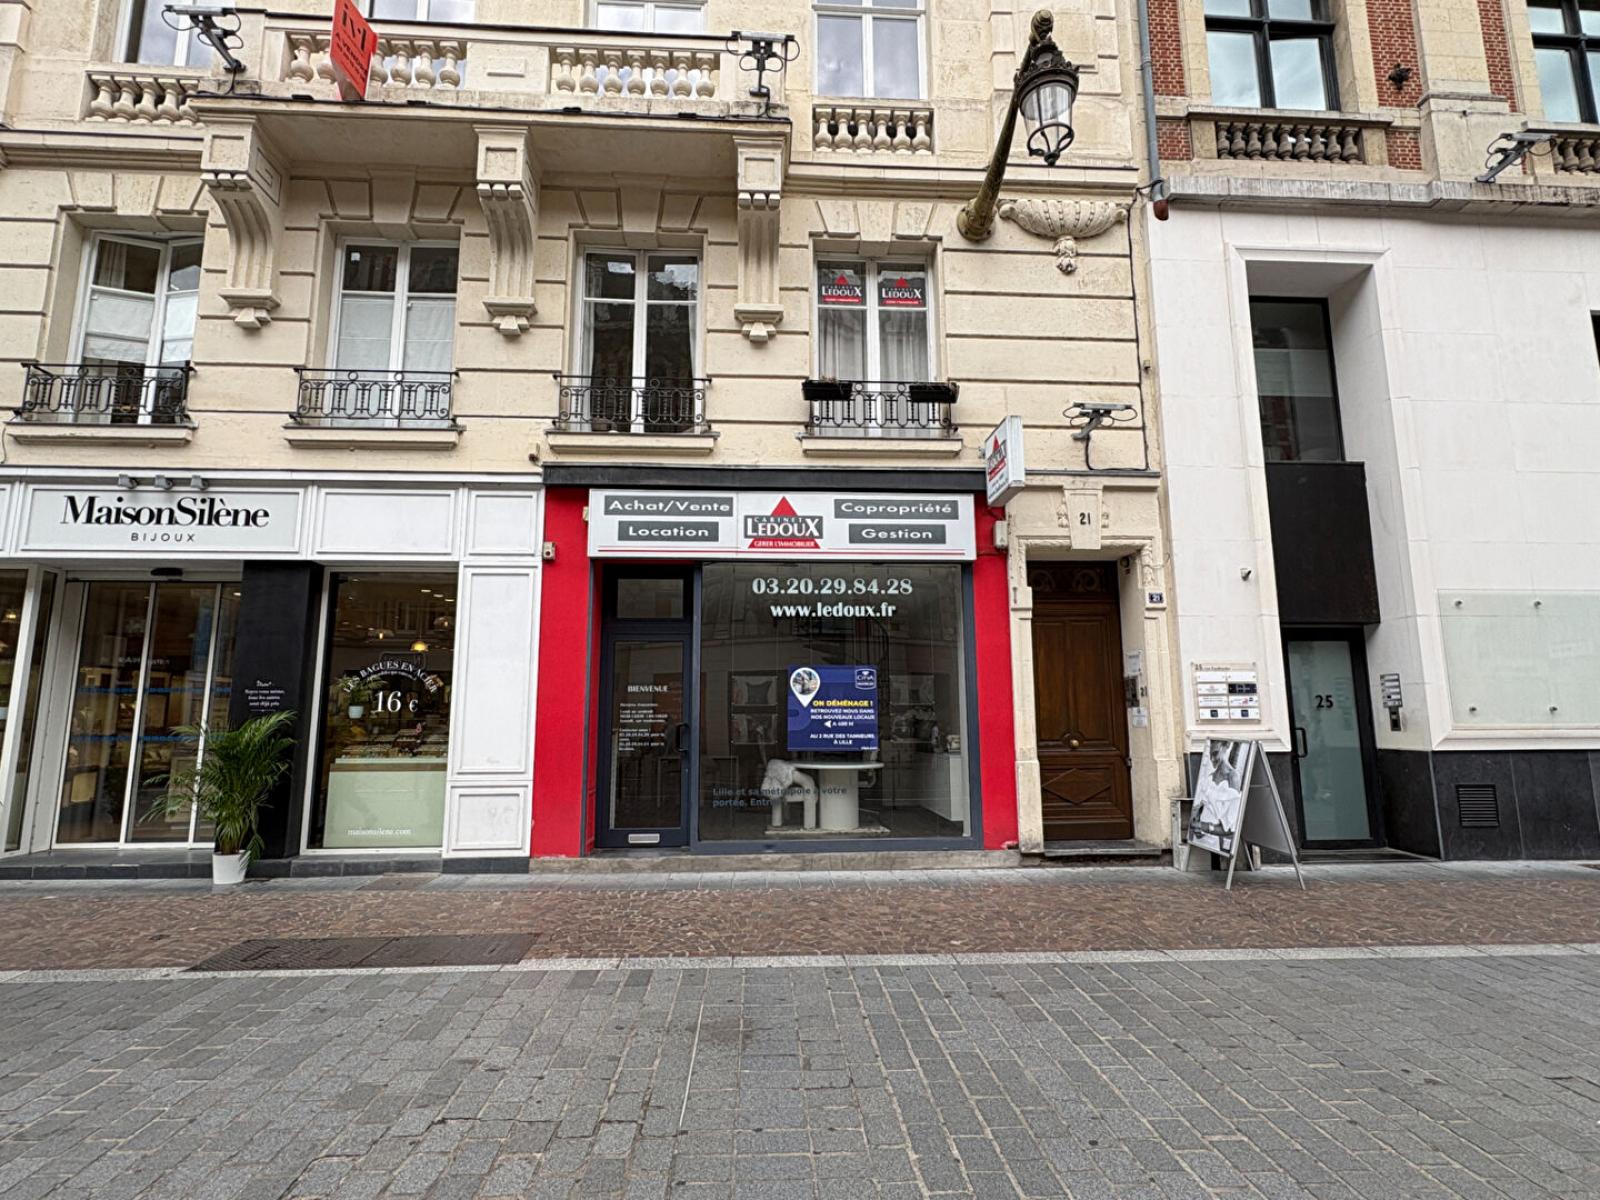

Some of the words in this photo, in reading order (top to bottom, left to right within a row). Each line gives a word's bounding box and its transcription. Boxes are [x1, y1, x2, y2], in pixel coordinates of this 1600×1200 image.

[821, 285, 862, 296] LEDOUX
[882, 288, 922, 299] LEDOUX
[609, 500, 730, 513] Achat/Vente
[841, 502, 952, 515] Copropriété
[1080, 512, 1090, 525] 21
[628, 526, 709, 537] Location
[747, 518, 820, 537] LEDOUX
[861, 529, 932, 539] Gestion
[131, 533, 195, 542] BIJOUX
[752, 578, 913, 595] 03.20.29.84.28
[770, 602, 896, 618] www.ledoux.fr
[360, 660, 399, 678] BAGUES
[374, 690, 402, 713] 16
[1315, 694, 1334, 708] 25
